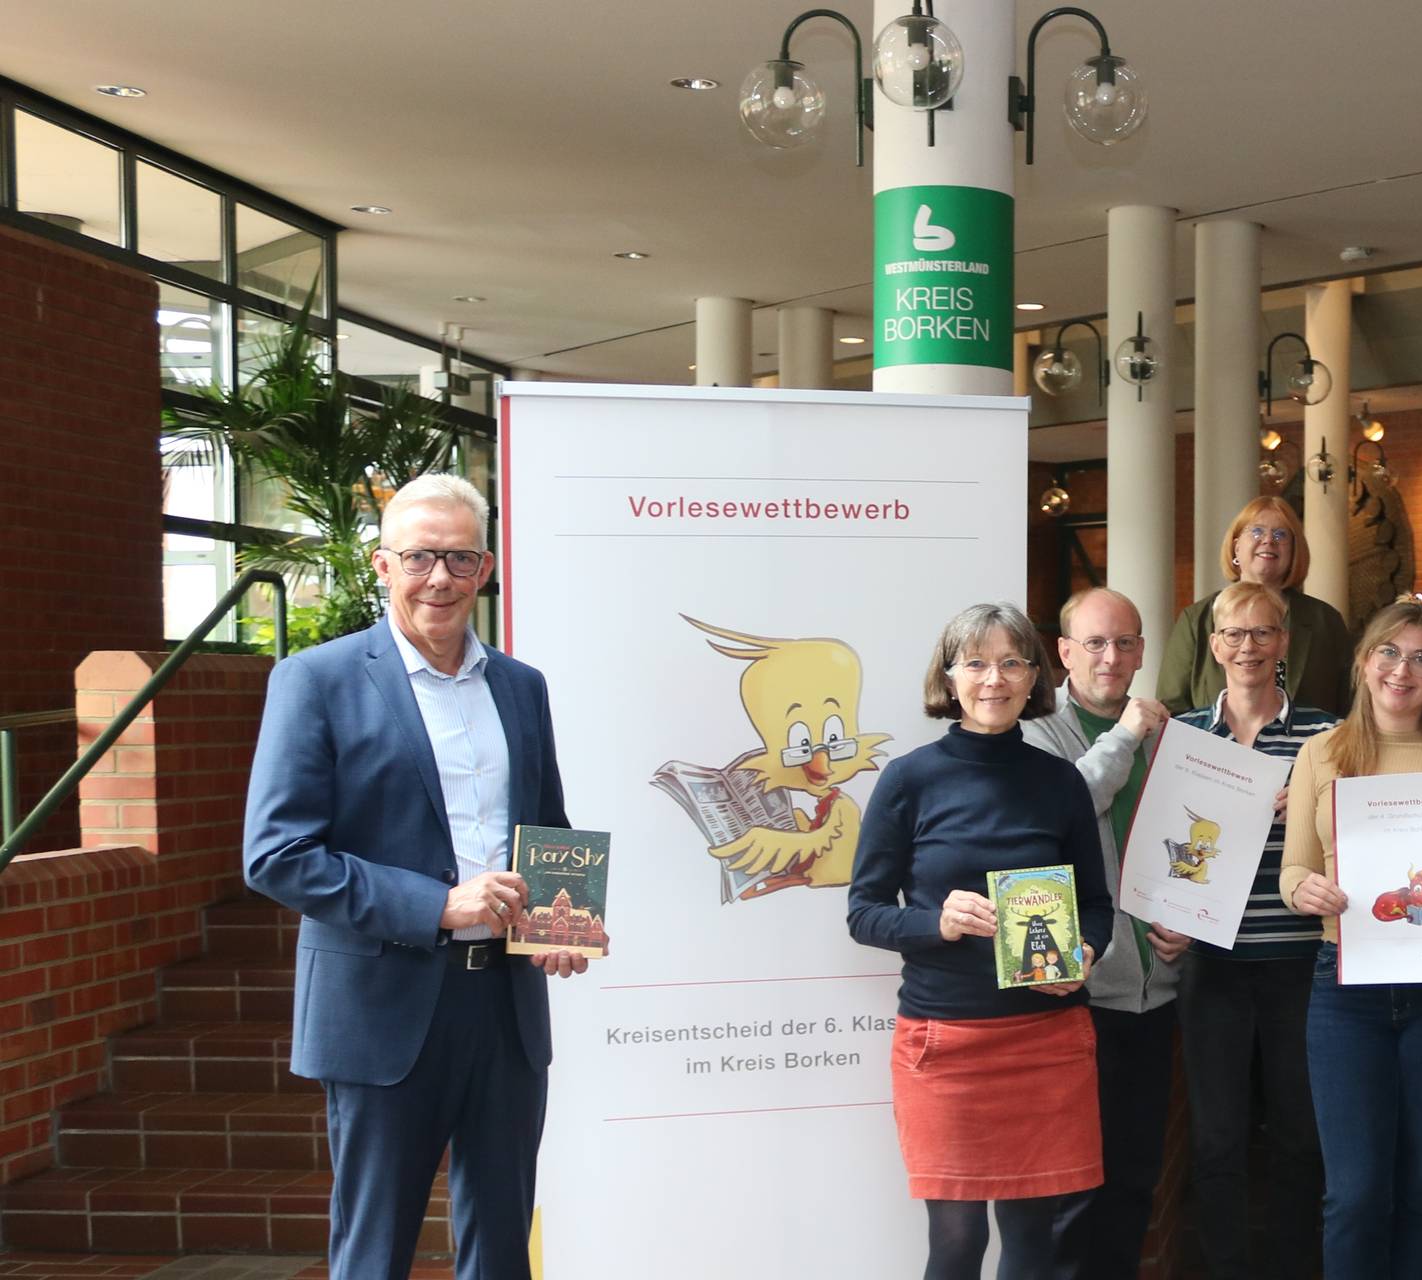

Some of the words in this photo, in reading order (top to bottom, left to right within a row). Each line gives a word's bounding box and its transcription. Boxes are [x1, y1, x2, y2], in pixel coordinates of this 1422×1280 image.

[885, 258, 990, 275] WESTMÜNSTERLAND
[896, 287, 974, 311] KREIS
[884, 316, 990, 342] BORKEN
[628, 494, 911, 520] Vorlesewettbewerb
[1185, 753, 1254, 784] Vorlesewettbewerb
[571, 846, 605, 868] Shy
[1006, 892, 1064, 907] TIERWANDLER
[606, 1020, 772, 1045] Kreisentscheid
[781, 1019, 817, 1036] der
[824, 1017, 843, 1033] 6.
[686, 1057, 711, 1074] im
[721, 1054, 776, 1072] Kreis
[784, 1051, 860, 1069] Borken
